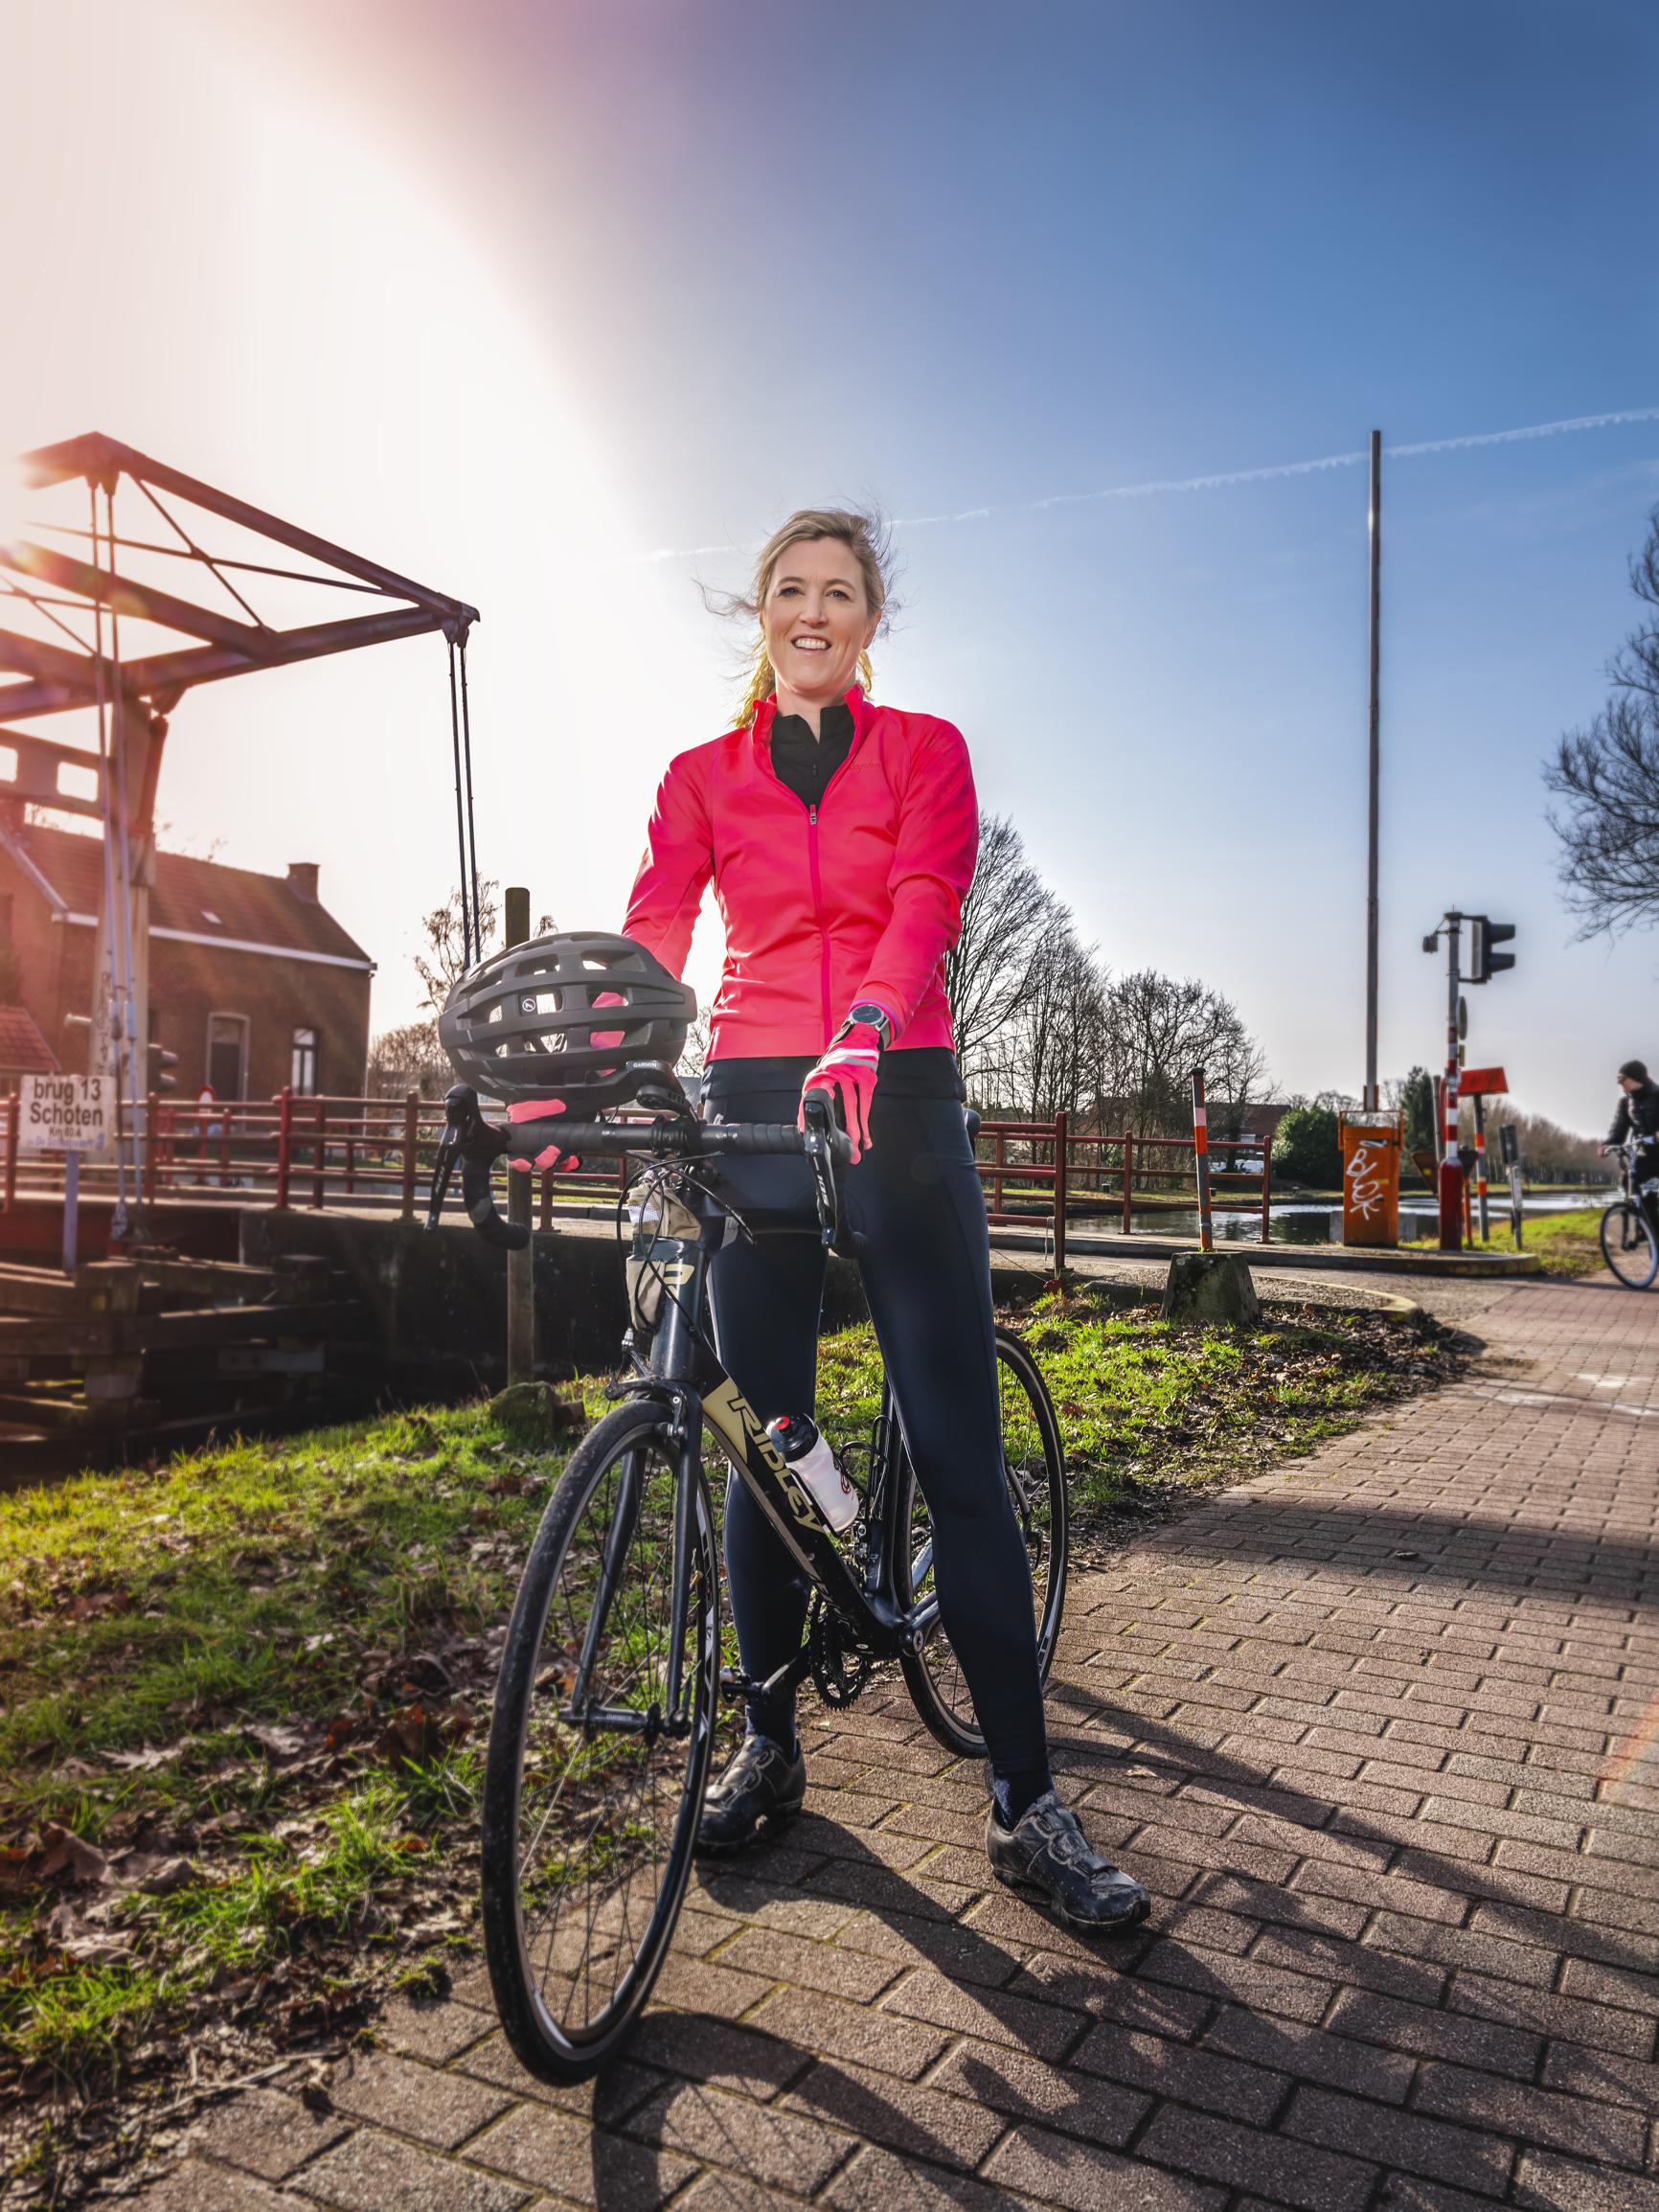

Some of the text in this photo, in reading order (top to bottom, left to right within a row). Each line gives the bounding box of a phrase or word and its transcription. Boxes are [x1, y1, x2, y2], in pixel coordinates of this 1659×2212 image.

[34, 1077, 102, 1106] brug 13
[30, 1102, 103, 1126] Schoten
[729, 1396, 827, 1534] RIDLEY
